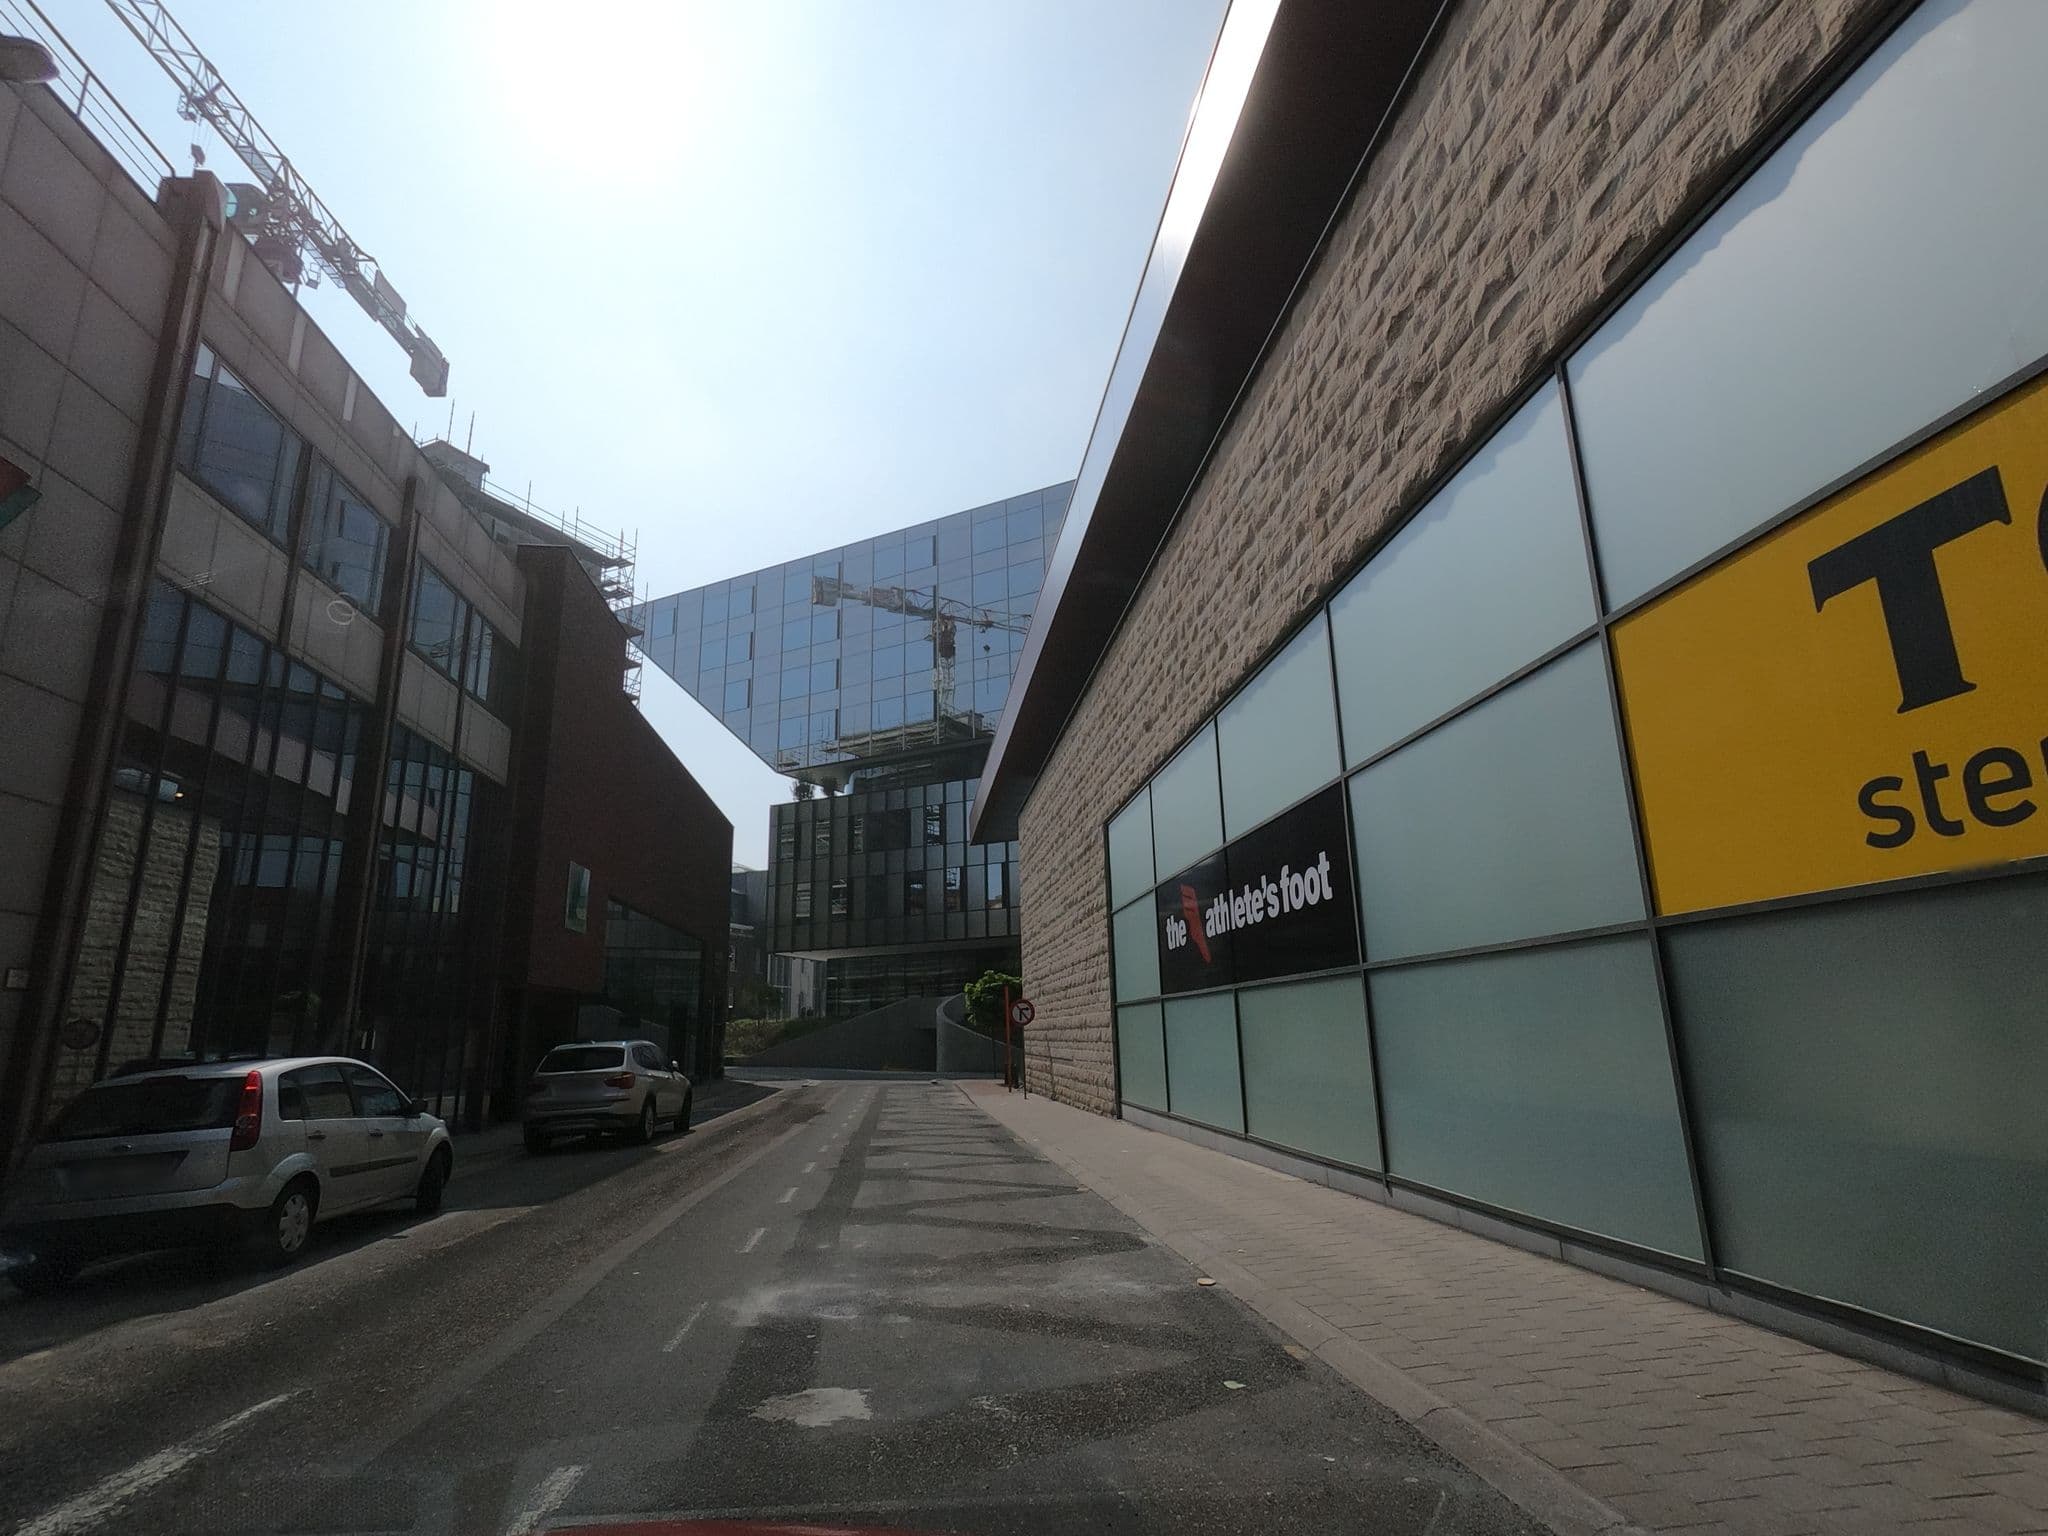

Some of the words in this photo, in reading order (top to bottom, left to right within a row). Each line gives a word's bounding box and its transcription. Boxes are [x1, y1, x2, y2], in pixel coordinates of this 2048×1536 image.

[1807, 465, 2048, 715] T
[1858, 737, 2048, 849] ste
[1166, 915, 1187, 950] the
[1205, 874, 1280, 938] athlete's
[1280, 851, 1333, 913] foot
